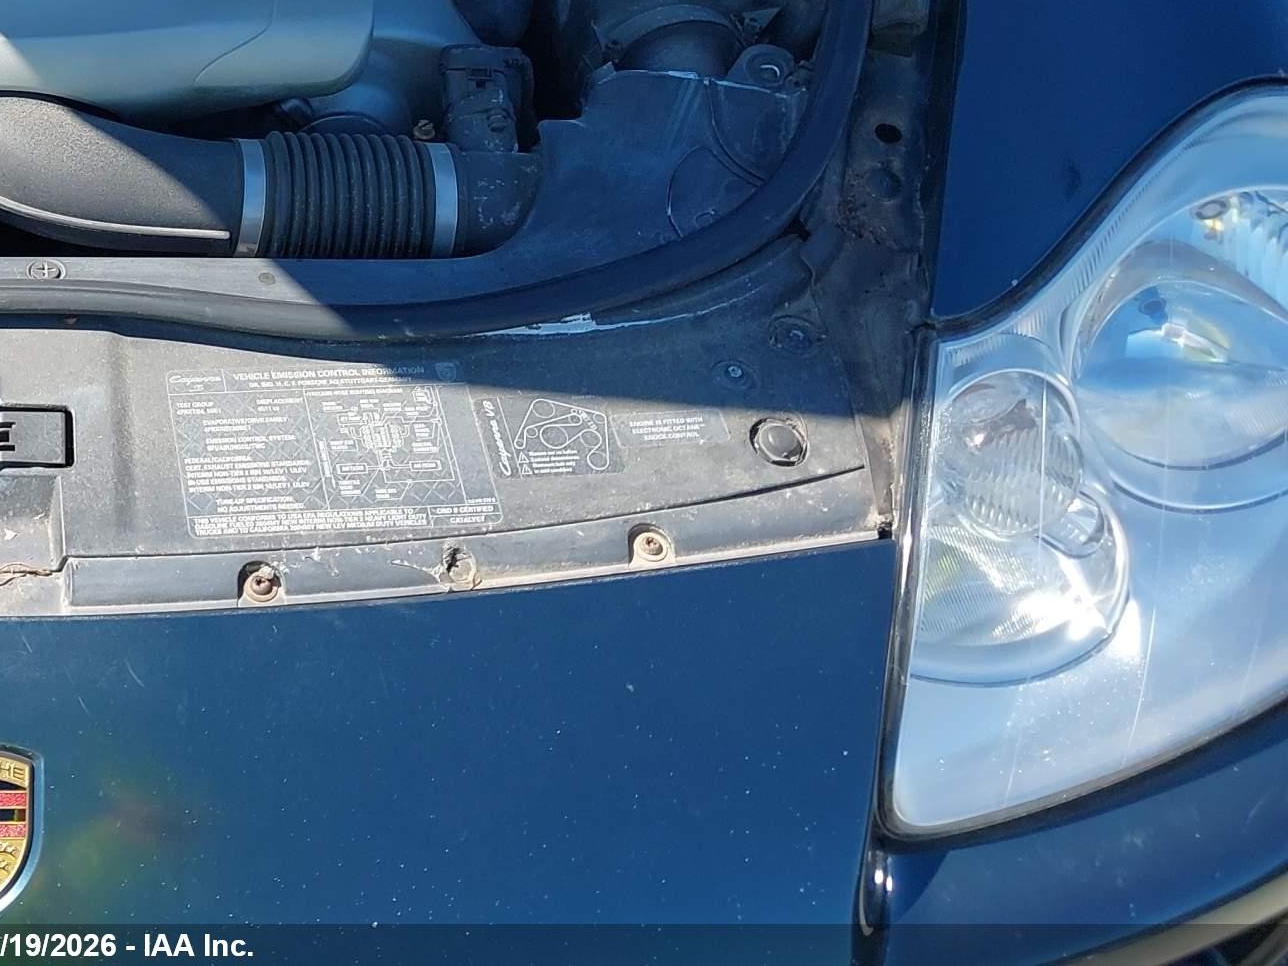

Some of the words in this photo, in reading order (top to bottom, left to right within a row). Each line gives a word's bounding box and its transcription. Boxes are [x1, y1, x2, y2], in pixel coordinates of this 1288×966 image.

[233, 372, 270, 381] VEHICLE
[271, 370, 316, 380] EMISSION
[317, 368, 360, 378] CONTROL
[361, 366, 425, 376] INFORMATION
